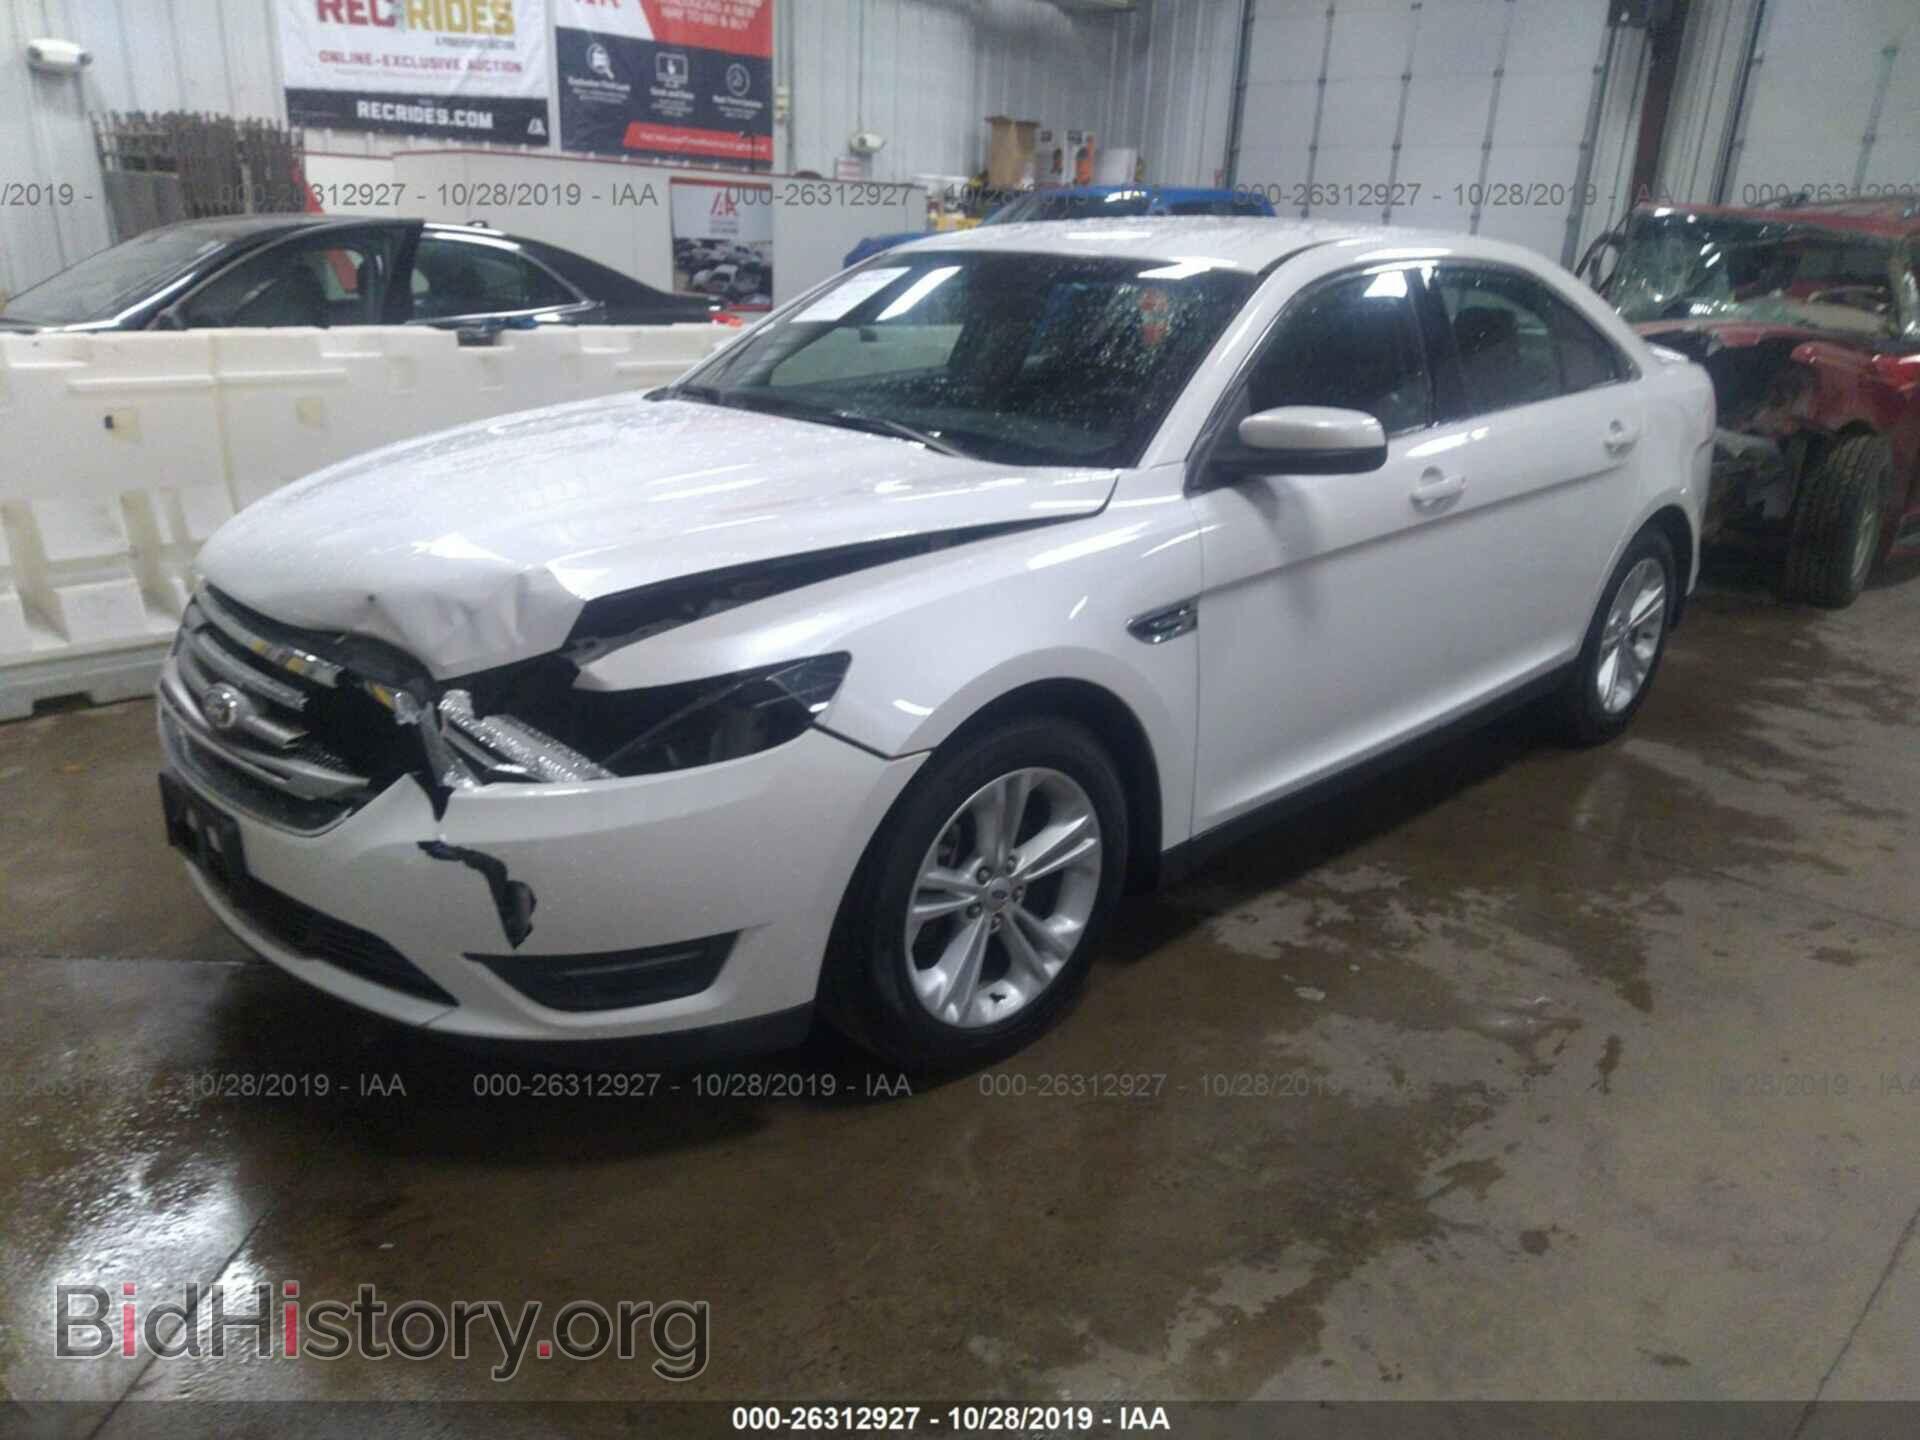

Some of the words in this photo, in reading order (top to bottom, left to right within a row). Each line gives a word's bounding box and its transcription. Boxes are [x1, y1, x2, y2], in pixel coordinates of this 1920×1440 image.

[318, 0, 396, 28] REC
[407, 0, 515, 35] RIDES
[318, 49, 461, 71] ONLINE-EXCLUSIVE
[466, 57, 523, 74] AUCTION
[356, 99, 494, 129] RECRIDES.COM
